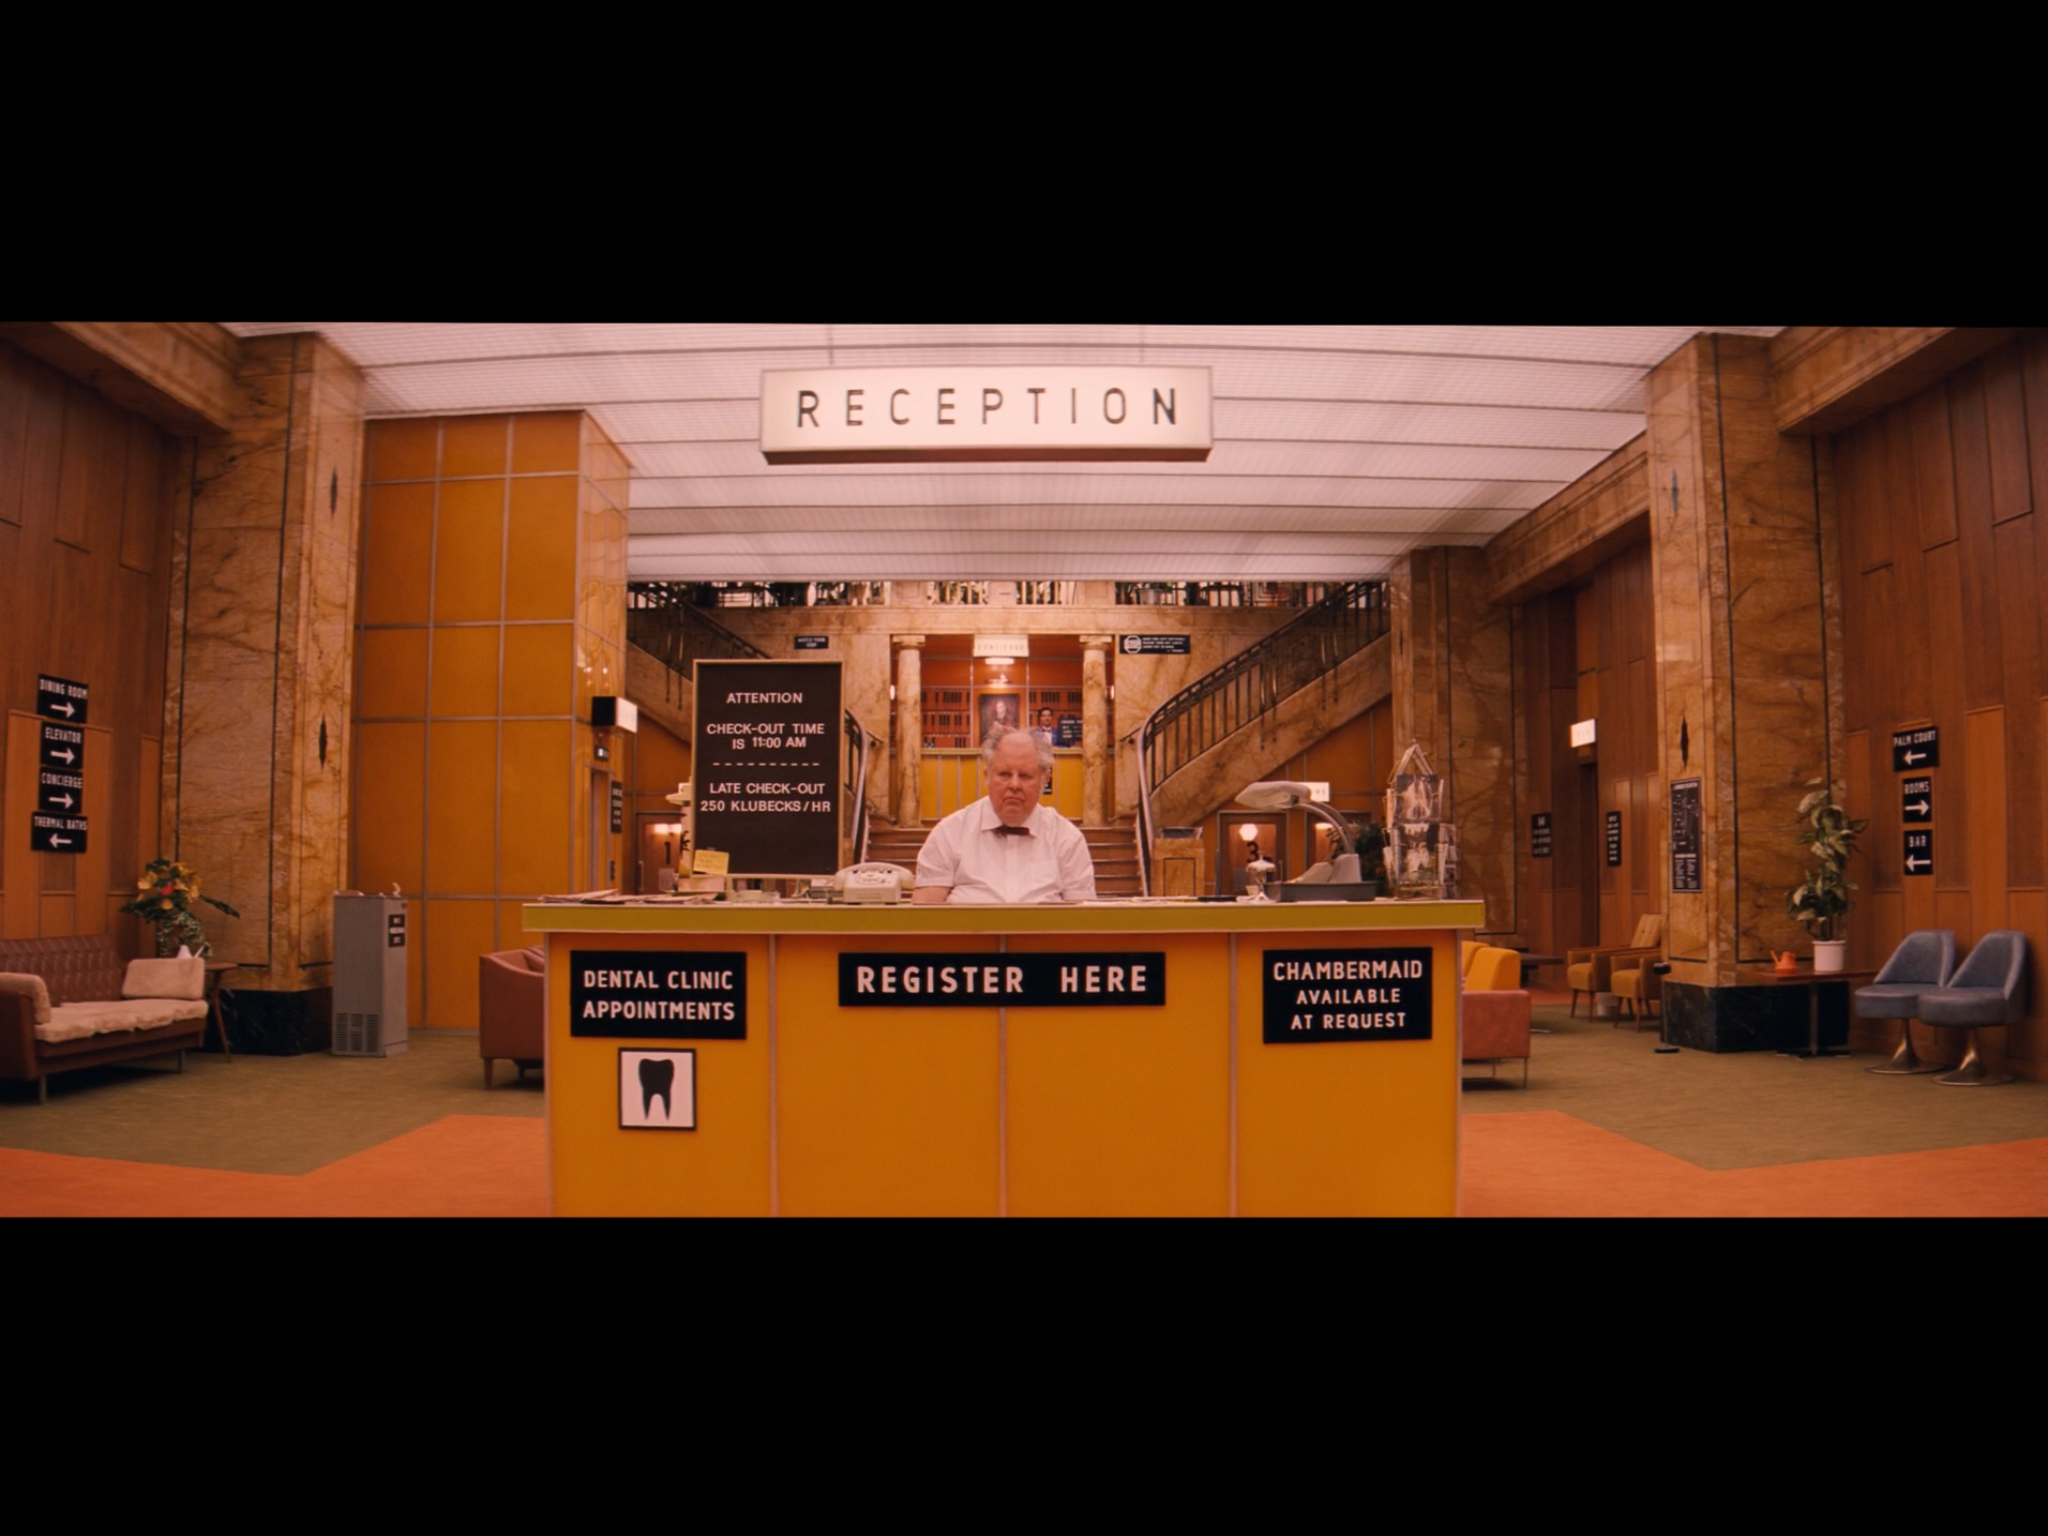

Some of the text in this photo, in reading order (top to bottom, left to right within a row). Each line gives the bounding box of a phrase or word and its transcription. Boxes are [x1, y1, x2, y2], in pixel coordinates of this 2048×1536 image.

[797, 387, 1177, 428] RECEPTION
[39, 678, 88, 699] DINING ROOM
[726, 692, 803, 704] ATTENTION
[45, 726, 82, 744] ELEVATOR
[706, 723, 825, 735] CHECK-OUT TIME
[732, 737, 806, 750] IS 11:00 AM
[1893, 730, 1936, 747] PALM COURT
[41, 772, 83, 789] CONCIERGE
[709, 783, 825, 795] LATE CHECK-OUT
[1904, 781, 1930, 795] ROOMS
[700, 800, 725, 812] 250
[34, 815, 88, 831] THERMAL BATHS
[1908, 835, 1927, 848] BAR
[1247, 841, 1259, 863] 3
[857, 965, 1147, 993] REGISTER HERE
[1273, 960, 1423, 981] CHAMBERMAID
[583, 970, 733, 990] DENTAL CLINIC
[1296, 988, 1401, 1005] AVAILABLE
[582, 1000, 736, 1021] APPOINTMENTS
[1290, 1012, 1406, 1030] AT REQUEST
